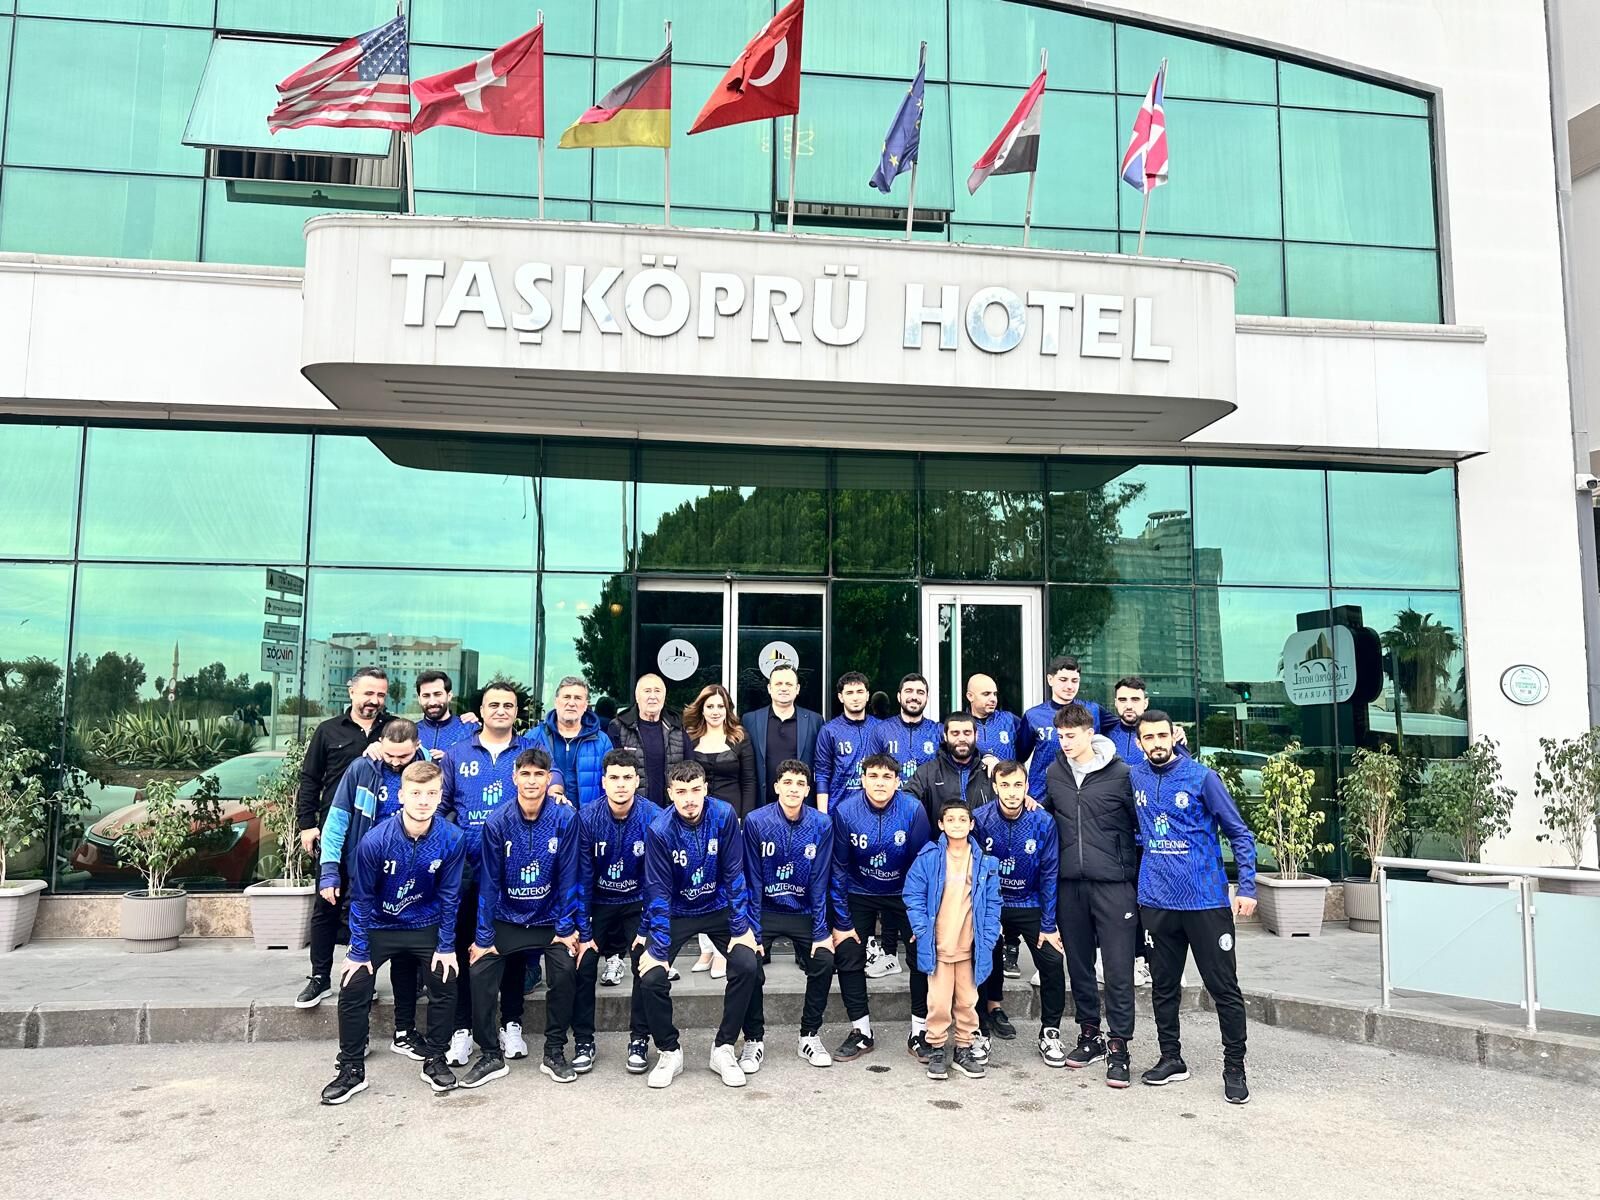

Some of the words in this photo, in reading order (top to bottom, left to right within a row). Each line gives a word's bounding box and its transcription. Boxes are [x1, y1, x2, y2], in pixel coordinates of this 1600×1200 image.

[390, 254, 868, 346] TAŞKÖPRÜ
[902, 283, 1173, 363] HOTEL
[1037, 727, 1054, 741] 37
[838, 741, 853, 755] 13
[888, 740, 898, 754] 11
[460, 760, 479, 777] 48
[850, 832, 868, 849] 36
[1148, 839, 1190, 850] NZTEKNIK
[594, 841, 607, 857] 17
[760, 841, 776, 858] 10
